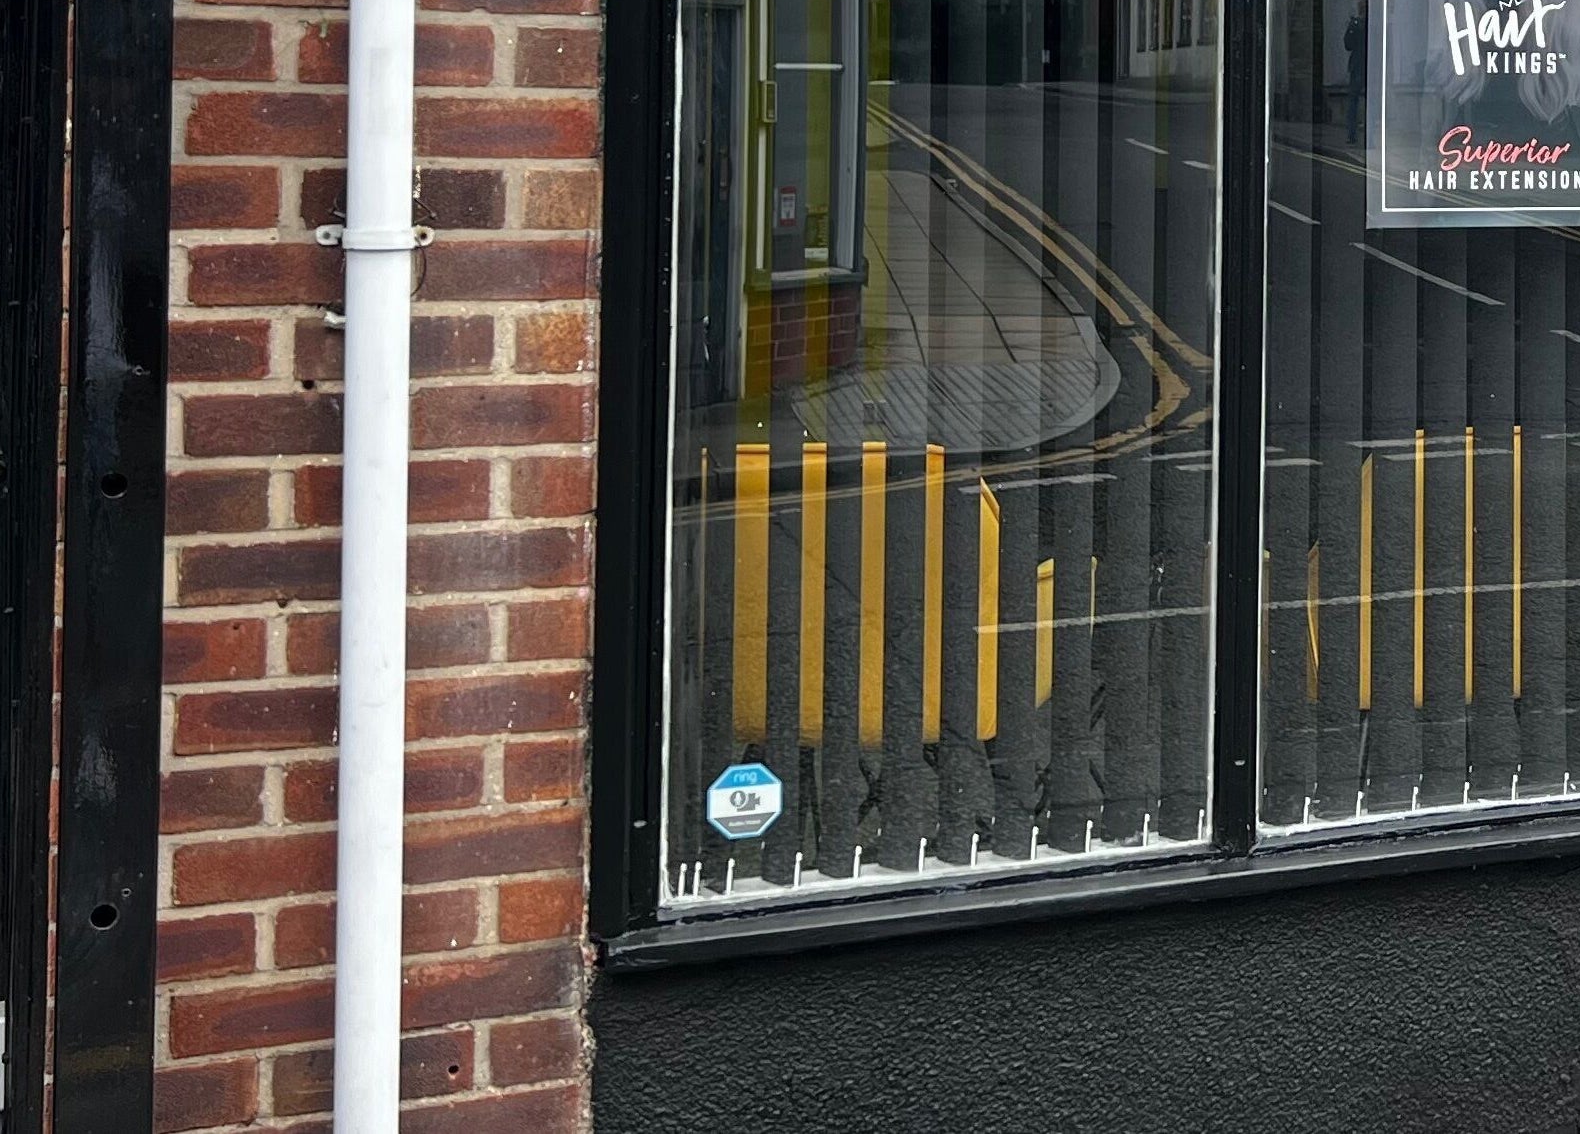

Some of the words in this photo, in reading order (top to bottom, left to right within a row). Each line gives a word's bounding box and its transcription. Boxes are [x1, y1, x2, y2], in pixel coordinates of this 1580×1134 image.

[1438, 125, 1572, 173] Superior
[1409, 170, 1457, 190] HAIR
[733, 771, 758, 785] ring
